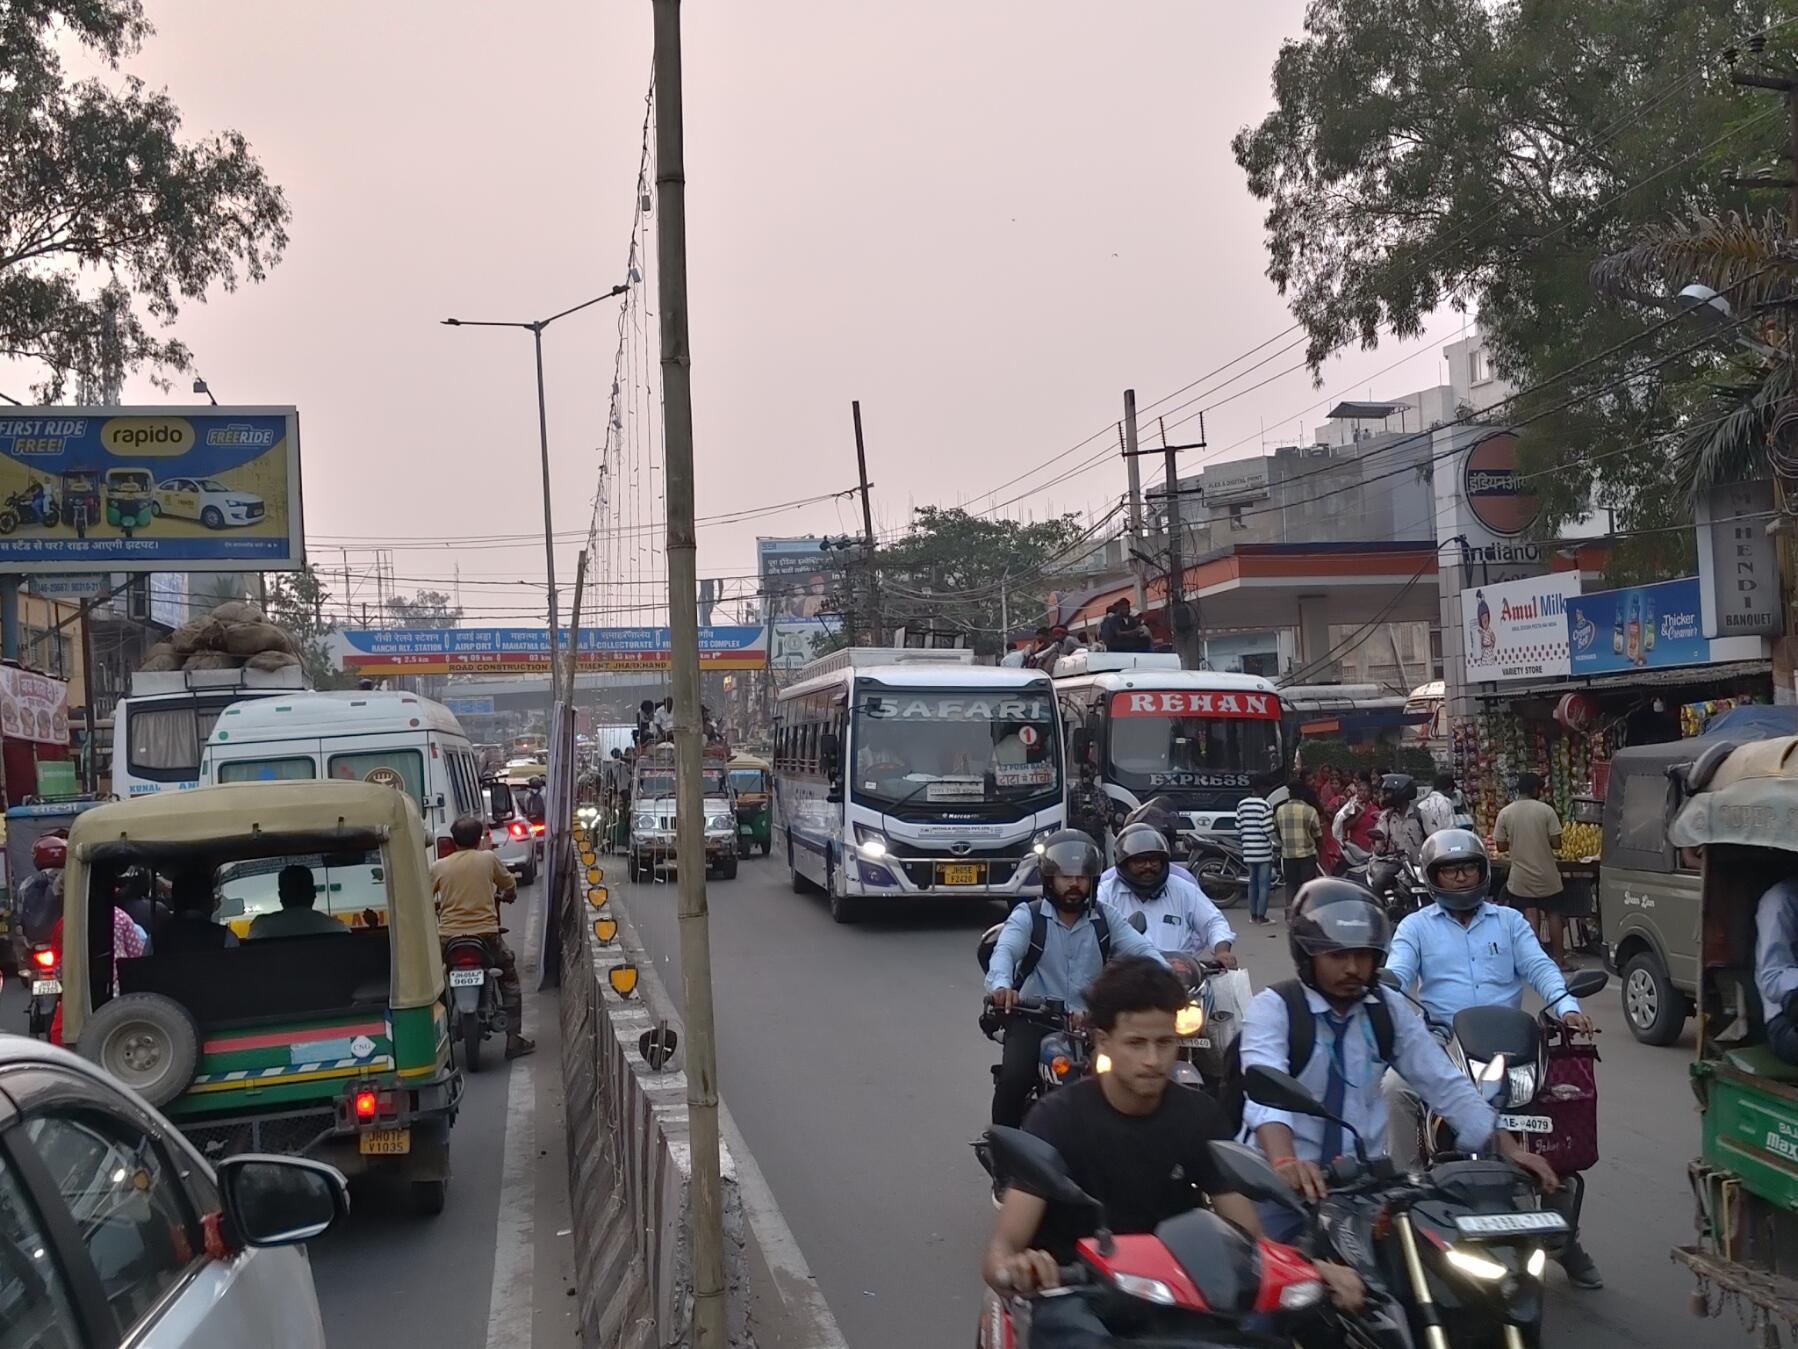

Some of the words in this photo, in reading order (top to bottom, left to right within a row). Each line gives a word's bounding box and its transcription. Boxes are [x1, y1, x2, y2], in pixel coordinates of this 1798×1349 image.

[0, 420, 43, 436] FIRST
[44, 420, 85, 436] RIDE
[113, 425, 183, 447] rapido
[15, 438, 63, 452] FREE!
[1501, 595, 1538, 622] Amul
[1540, 592, 1567, 617] Milk
[1663, 612, 1695, 626] Thicker
[1726, 613, 1771, 626] BANQUET
[1660, 623, 1668, 637] &
[414, 644, 442, 652] STATION
[455, 643, 492, 651] AIRPORT
[502, 642, 538, 650] MAHATMA
[596, 640, 654, 649] COLLECTORATE
[709, 639, 740, 648] COMPLEX
[477, 662, 548, 671] CONSTRUCTION
[1502, 666, 1524, 676] VARIETY
[1525, 665, 1543, 675] STORE
[868, 700, 1041, 720] SAFARI
[1130, 693, 1268, 714] REHAN
[1150, 773, 1250, 787] EXPRESS
[1525, 1119, 1549, 1130] 4079
[368, 1142, 404, 1153] V1035
